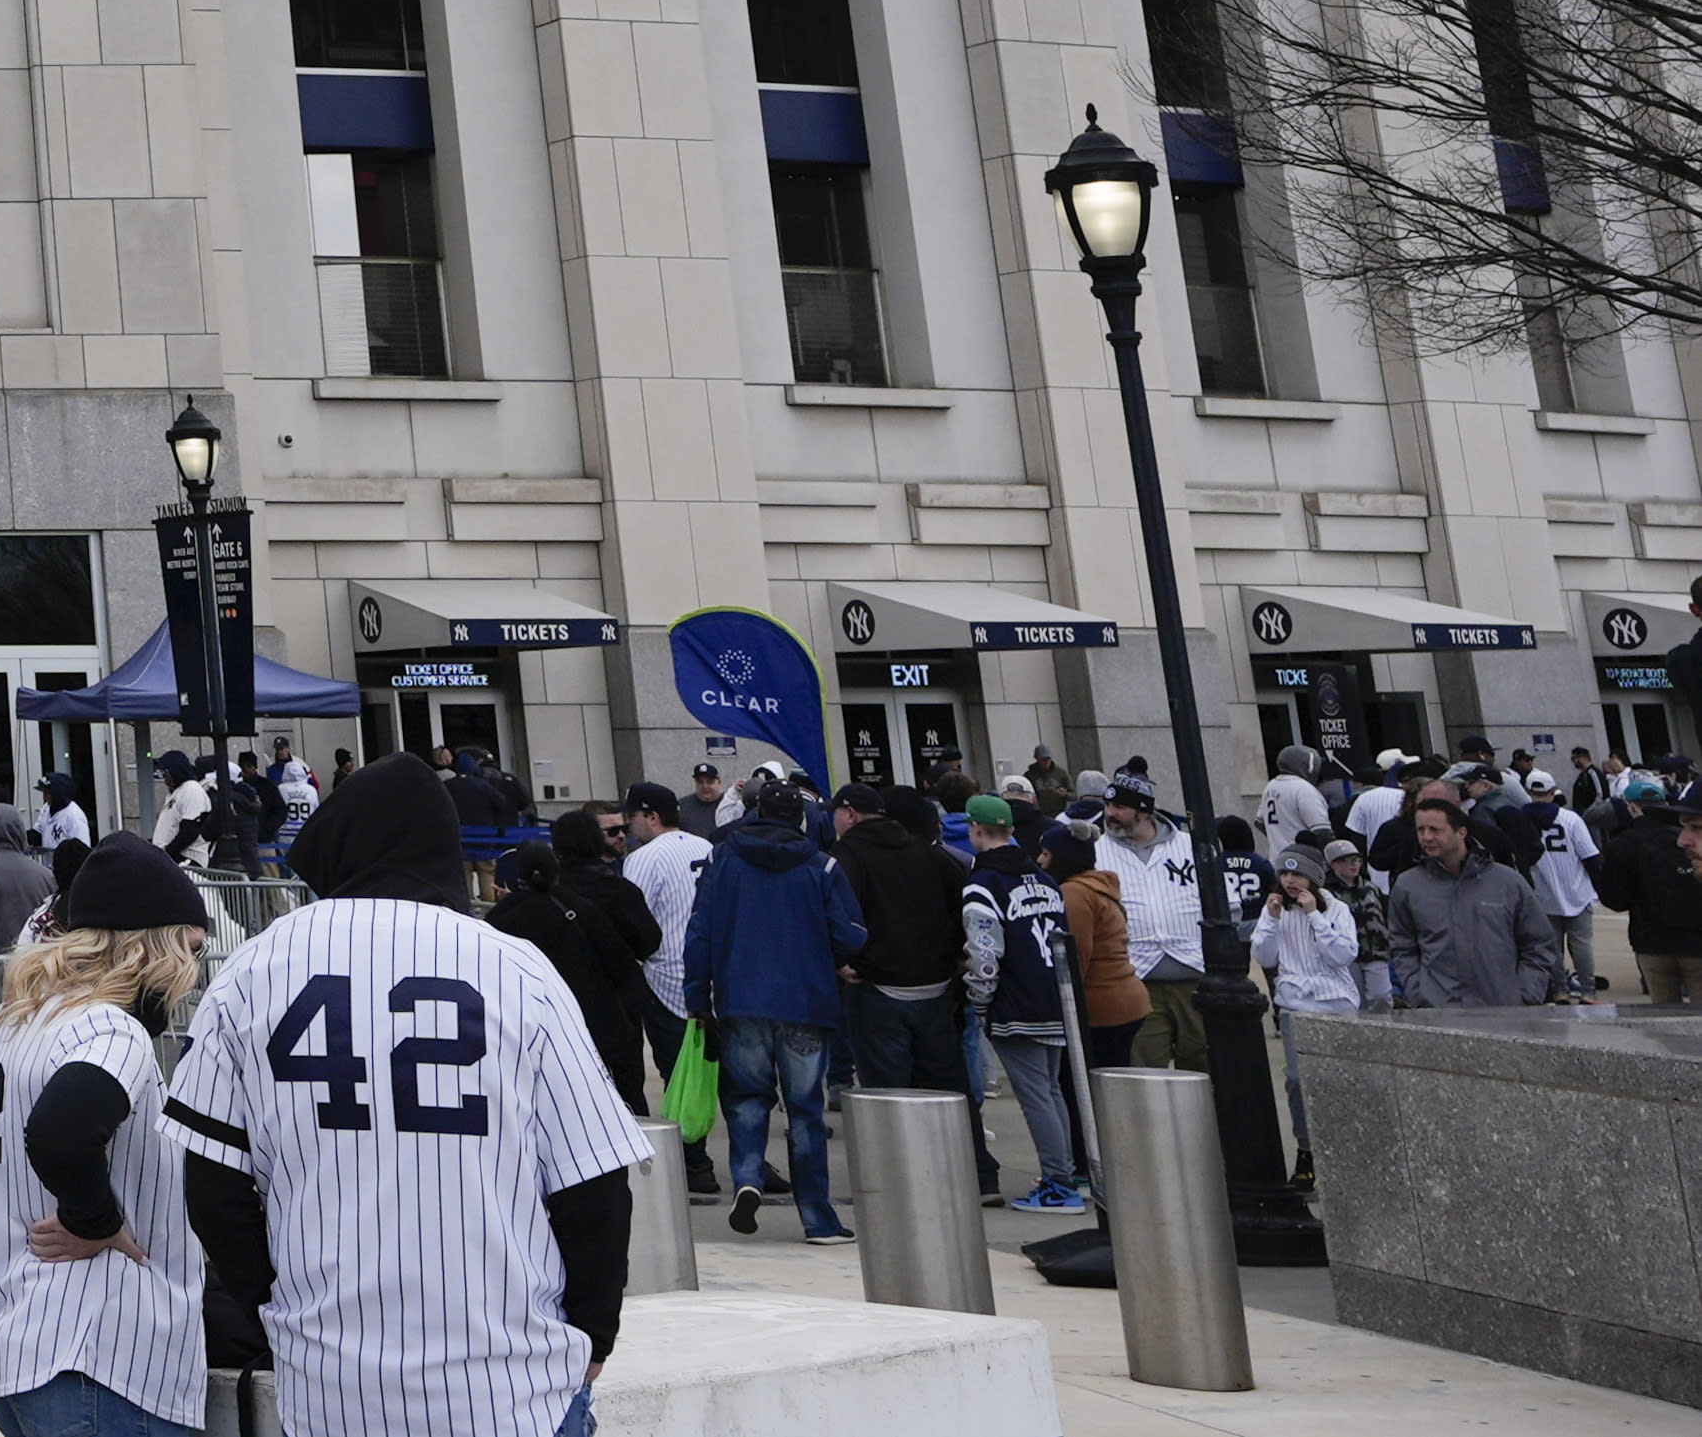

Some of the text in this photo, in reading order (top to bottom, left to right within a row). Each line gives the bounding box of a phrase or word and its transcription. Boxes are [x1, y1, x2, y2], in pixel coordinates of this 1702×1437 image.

[213, 541, 243, 558] GATE 6
[500, 624, 569, 641] TICKETS
[1015, 627, 1075, 643] TICKETS
[1449, 629, 1499, 645] TICKETS
[405, 664, 474, 676] TICKET OFFICE
[890, 664, 929, 686] EXIT
[391, 675, 489, 687] CUSTOMER SERVICE
[701, 690, 779, 714] CLEAR
[1319, 719, 1347, 732] TICKET
[1322, 734, 1351, 749] OFFICE
[287, 802, 311, 821] 99
[1267, 800, 1279, 825] 2
[1541, 823, 1568, 852] 2
[1226, 857, 1251, 869] SOTO
[1164, 858, 1196, 886] NY
[267, 974, 489, 1137] 42
